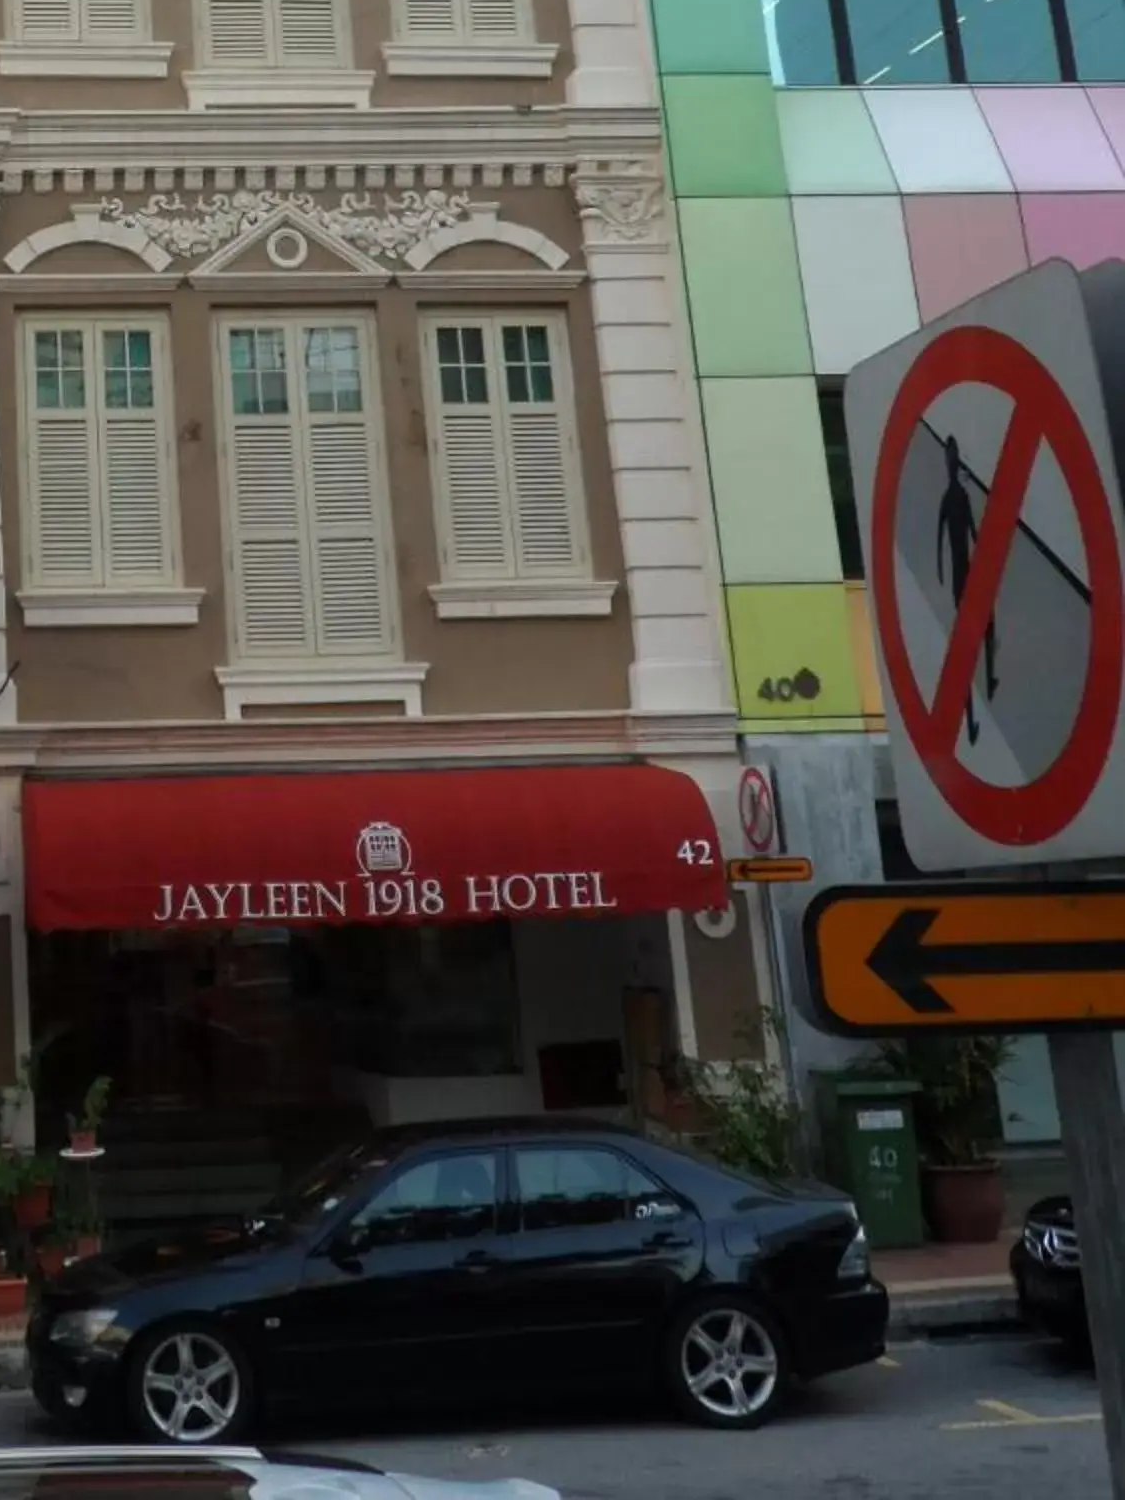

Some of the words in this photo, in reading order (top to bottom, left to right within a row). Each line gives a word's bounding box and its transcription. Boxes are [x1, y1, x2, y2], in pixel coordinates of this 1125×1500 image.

[676, 839, 714, 866] 42
[153, 881, 347, 922] JAYLEEN
[365, 878, 445, 916] 1918
[466, 871, 618, 913] HOTEL
